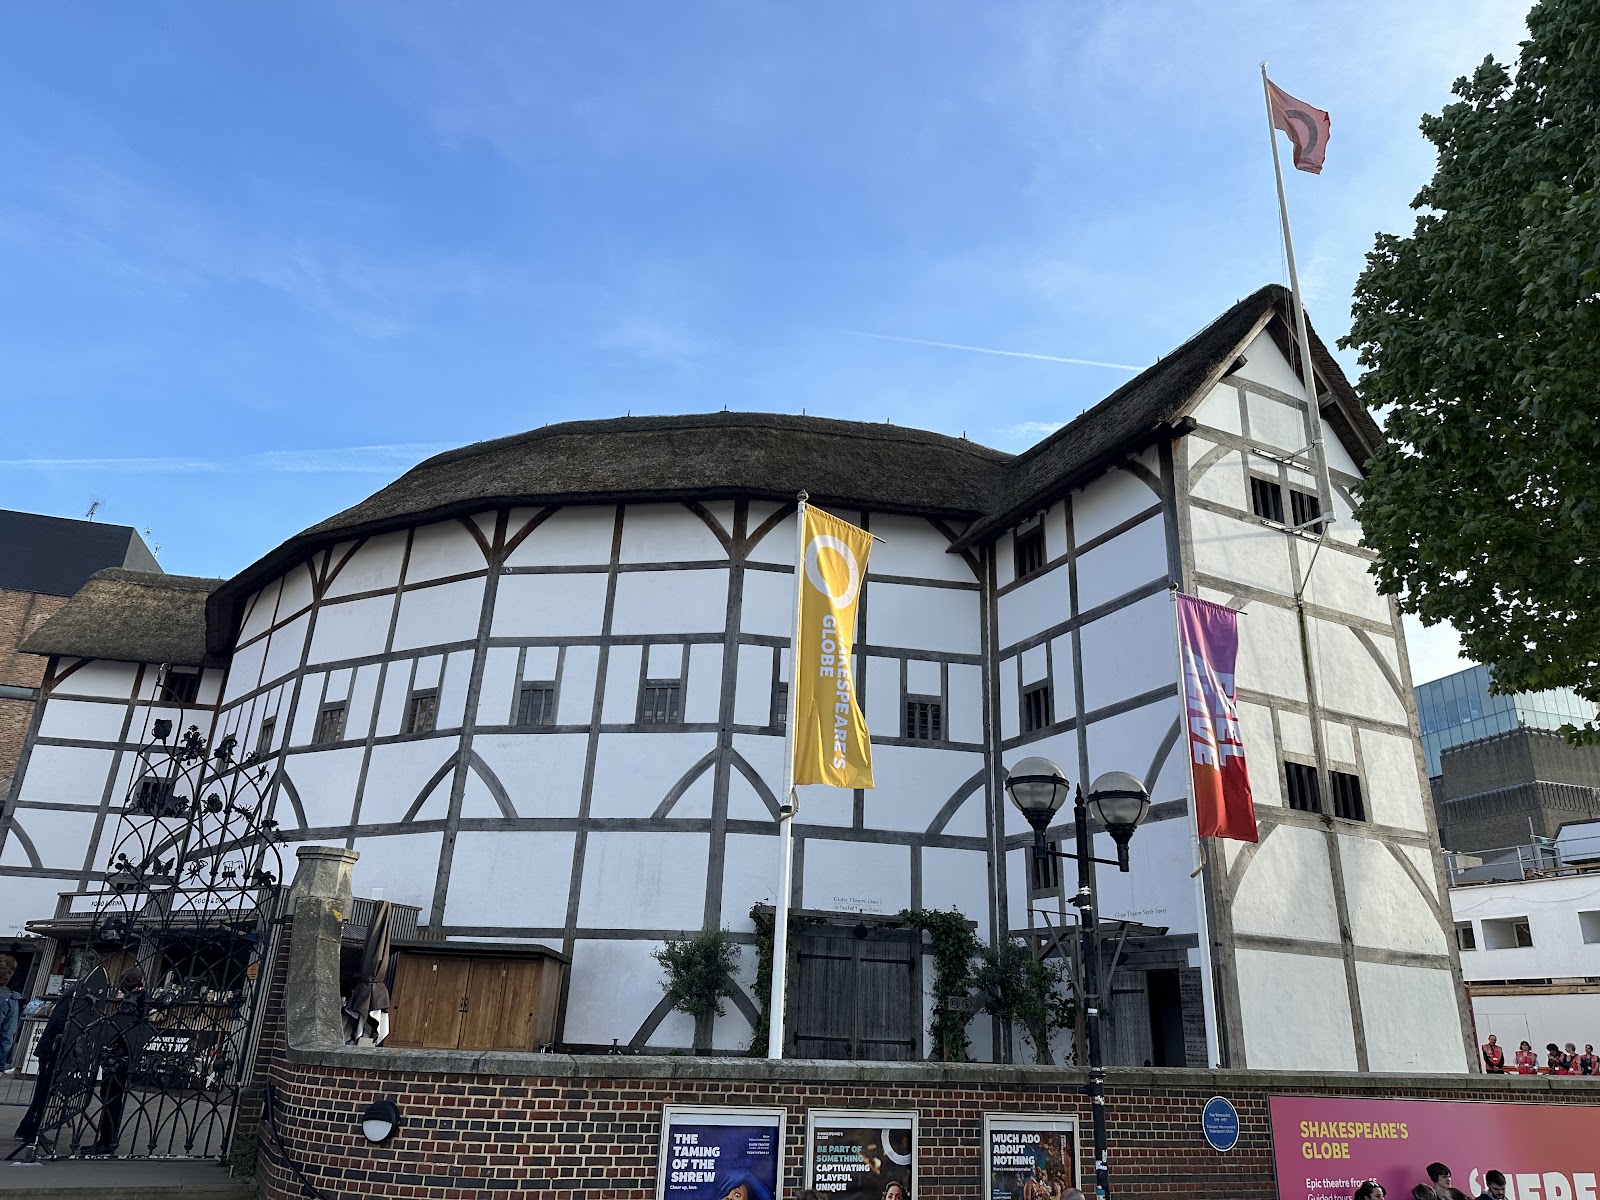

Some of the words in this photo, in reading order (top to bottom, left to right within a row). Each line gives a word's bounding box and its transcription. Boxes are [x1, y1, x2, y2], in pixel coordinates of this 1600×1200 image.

[820, 614, 836, 678] GLOBE
[1300, 1120, 1409, 1140] SHAKESPEARE'S
[673, 1133, 699, 1145] THE
[992, 1133, 1020, 1143] MUCH
[1020, 1133, 1041, 1144] ADO
[672, 1146, 721, 1158] TAMING
[817, 1145, 828, 1153] BE
[828, 1145, 849, 1153] PART
[993, 1144, 1025, 1154] ABOUT
[1302, 1141, 1351, 1160] GLOBE
[671, 1159, 689, 1170] OF
[691, 1159, 715, 1170] THE
[816, 1155, 864, 1163] SOMETHING
[993, 1155, 1035, 1165] NOTHING
[816, 1164, 871, 1172] CAPTIVATING
[670, 1171, 716, 1183] SHREW
[816, 1173, 853, 1182] PLAYFUL
[815, 1183, 847, 1193] UNIQUE
[1305, 1177, 1323, 1191] Epic
[1323, 1177, 1350, 1189] theatre
[1350, 1177, 1363, 1188] fro
